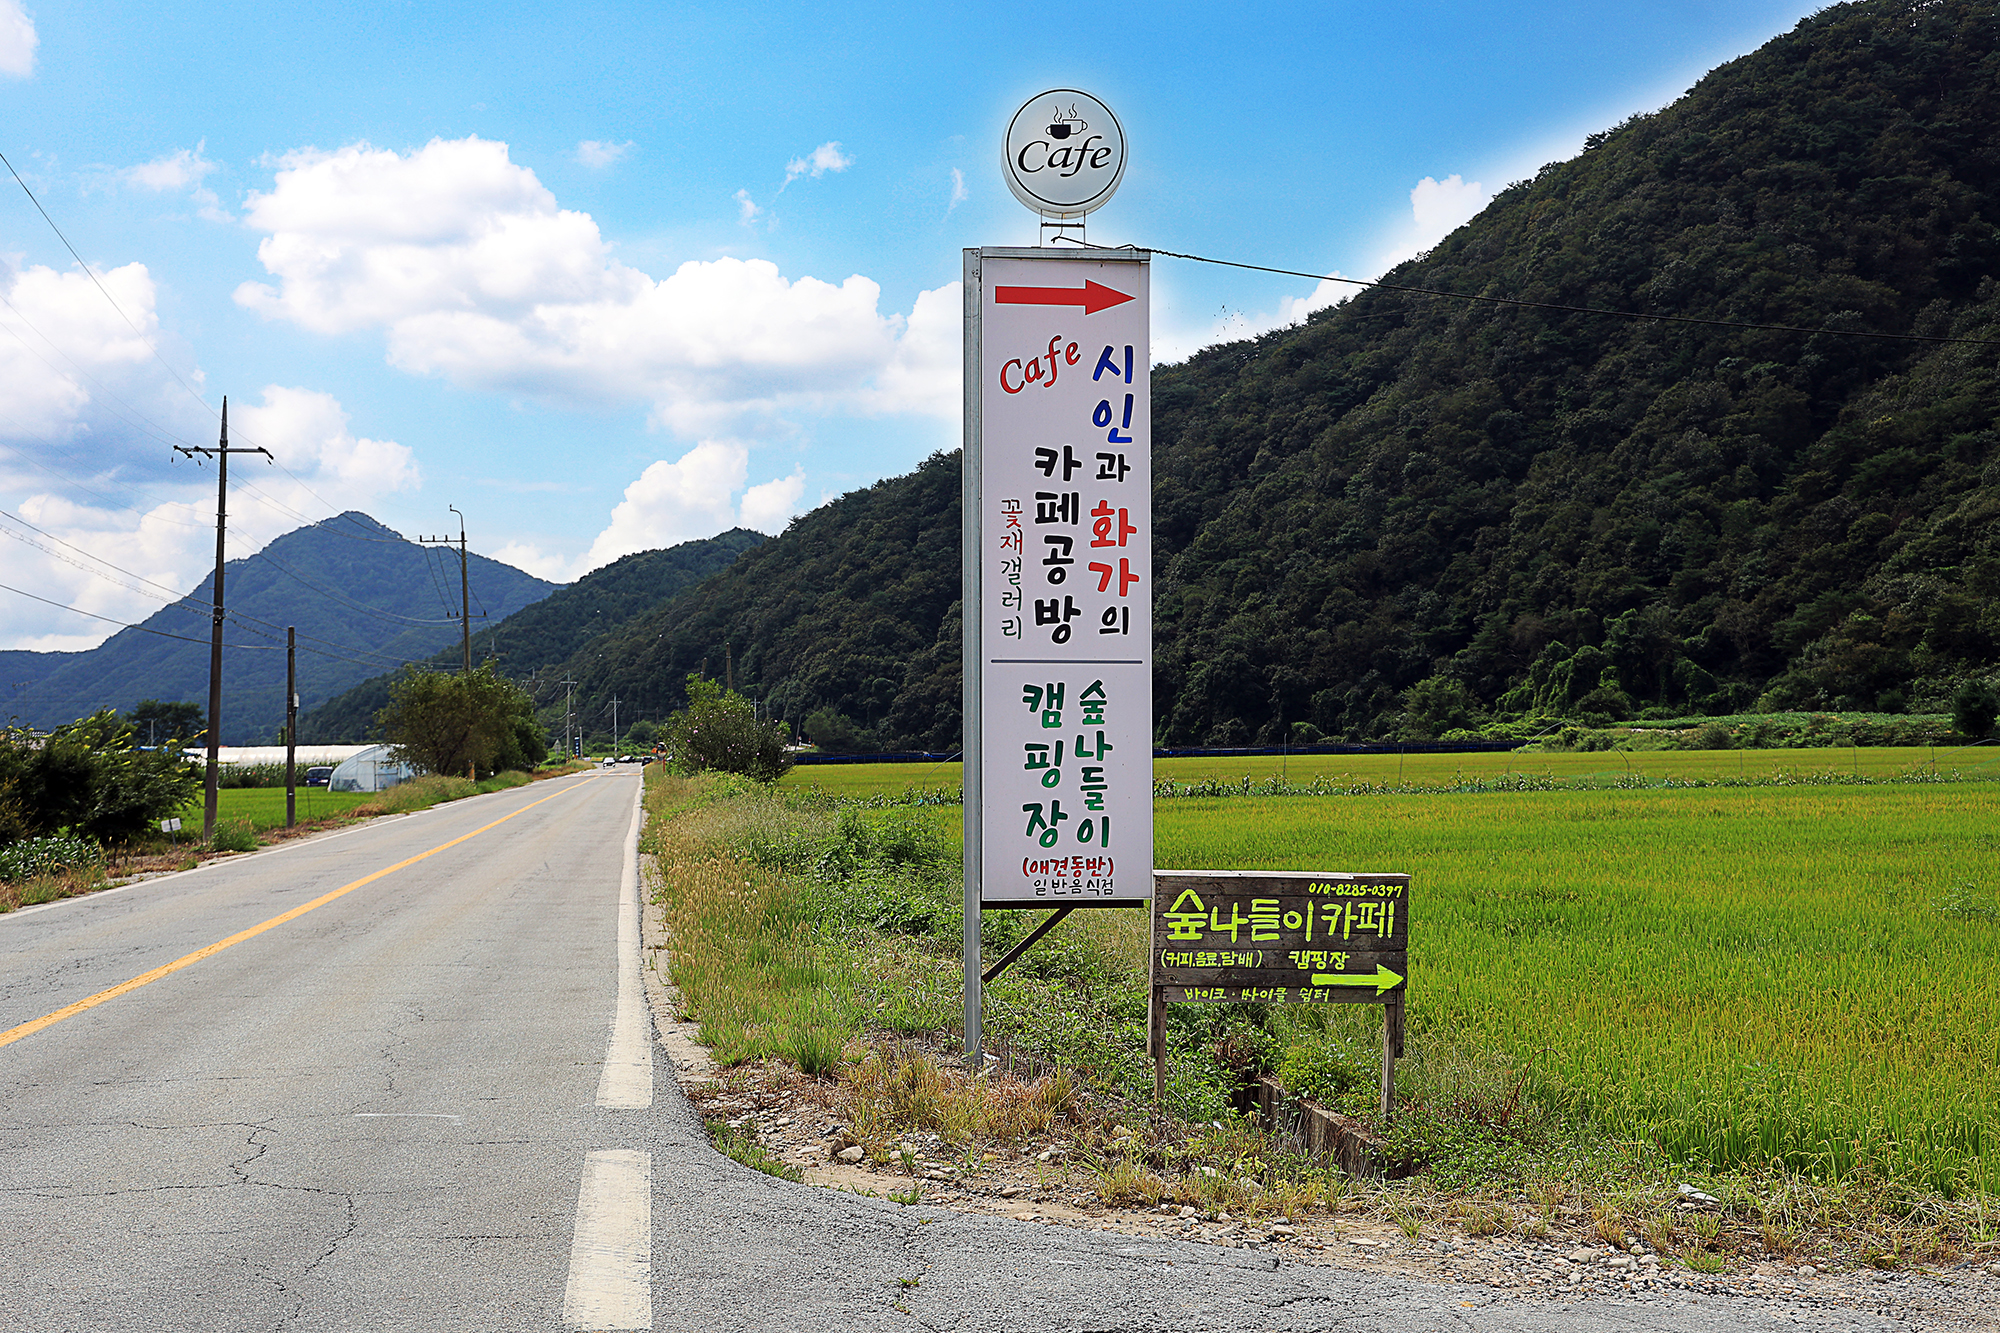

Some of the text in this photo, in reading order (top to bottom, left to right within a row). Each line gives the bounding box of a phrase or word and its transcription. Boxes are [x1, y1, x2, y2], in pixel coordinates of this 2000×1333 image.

[1017, 136, 1112, 177] Cafe
[1000, 335, 1081, 395] Cafe
[1088, 499, 1140, 635] 화가의
[1023, 682, 1068, 849] 캠핑장
[1074, 679, 1113, 848] 숲나들이
[1023, 855, 1114, 877] (애견동반)
[1033, 878, 1114, 896] 일반음식점
[1308, 882, 1403, 898] 010-8285-0397
[1289, 951, 1350, 970] 캠핑장
[1298, 986, 1330, 1001] 쉼터
